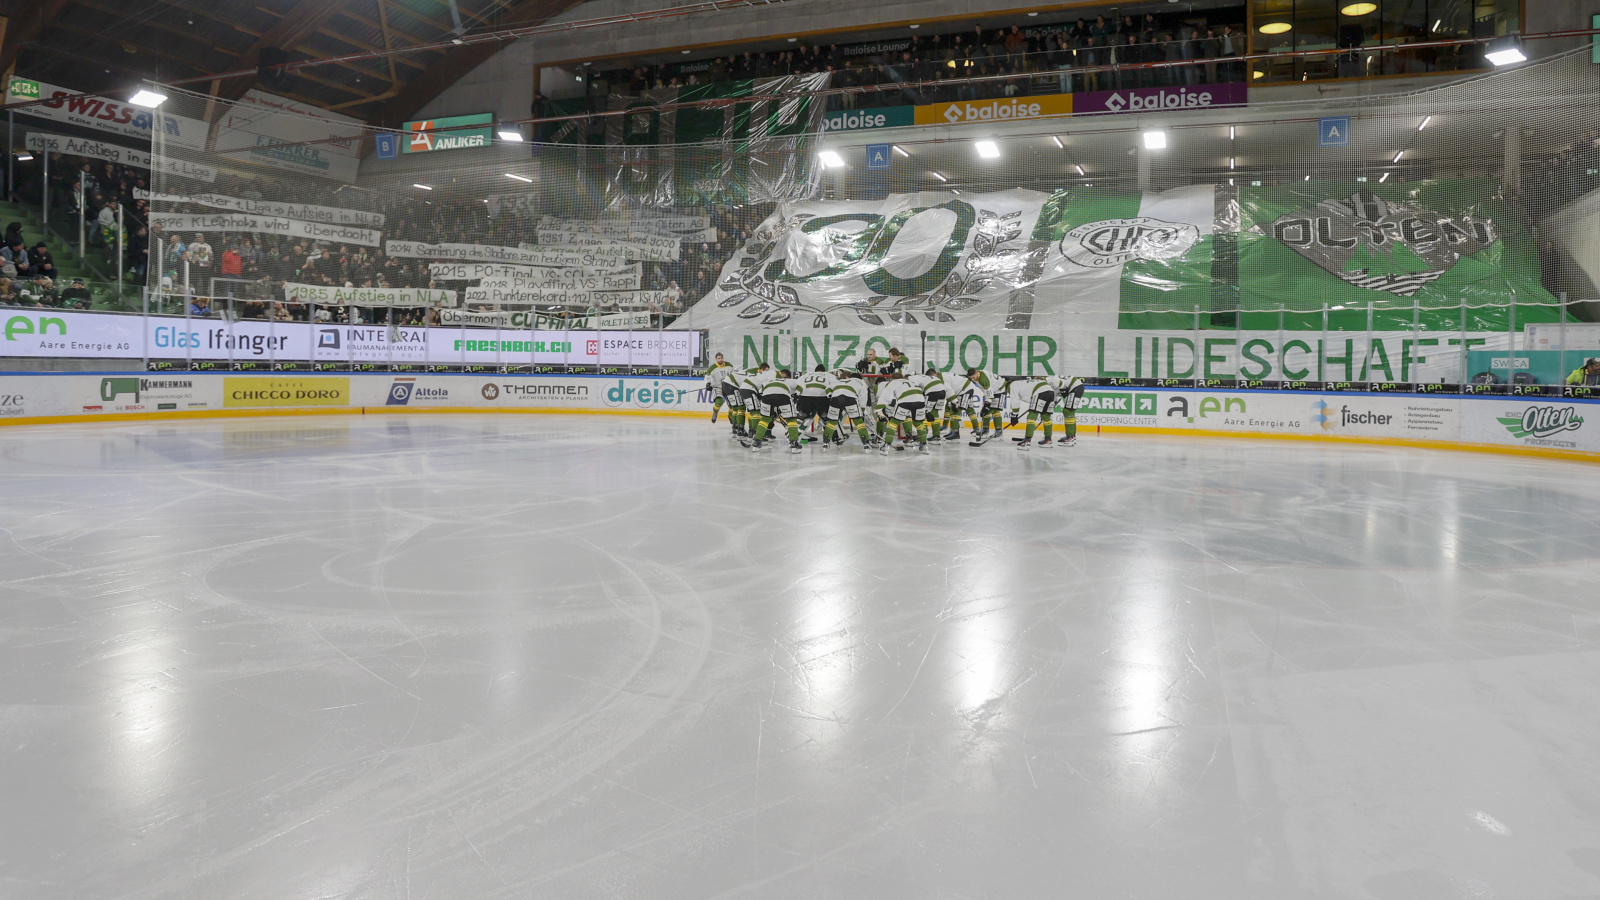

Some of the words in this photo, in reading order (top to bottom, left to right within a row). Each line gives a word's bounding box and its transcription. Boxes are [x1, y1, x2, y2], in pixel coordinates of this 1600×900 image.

[844, 45, 876, 56] Baloise
[1130, 88, 1212, 110] baloise
[966, 99, 1041, 120] baloise
[68, 116, 92, 126] Kälte
[96, 122, 120, 132] Klima
[1329, 126, 1340, 137] A
[381, 142, 390, 151] B
[435, 135, 485, 150] ANLIKER
[66, 139, 120, 161] Aufstieg
[128, 151, 139, 162] in
[874, 151, 884, 162] A
[690, 219, 704, 228] AG
[265, 218, 290, 230] wird
[304, 223, 374, 243] überdacht
[1272, 215, 1494, 249] OLTEN
[469, 247, 483, 258] des
[520, 253, 538, 263] zum
[581, 254, 617, 268] Stand
[432, 265, 466, 278] 2015
[603, 274, 636, 289] Rappi
[289, 286, 328, 300] 1985
[334, 288, 395, 303] Aufstieg
[400, 289, 411, 301] in
[417, 289, 449, 303] NLA
[154, 326, 201, 348] Glas
[208, 328, 288, 355] Ifanger
[347, 329, 427, 343] INTERAL
[40, 340, 66, 349] Aare
[71, 341, 111, 351] Energie
[116, 342, 130, 350] AG
[604, 339, 644, 350] ESPACE
[647, 340, 688, 350] BROKER
[927, 334, 1057, 376] JOHR
[1493, 360, 1528, 368] SWCA
[141, 378, 193, 391] KAMMERMANN
[503, 384, 588, 395] THOMMEN
[232, 389, 291, 400] CHICCO
[296, 389, 340, 400] D'ORO
[415, 387, 448, 397] Altola
[607, 380, 687, 404] dreier
[1, 394, 24, 407] ze
[1341, 405, 1392, 427] fischer
[1522, 405, 1580, 435] Olten
[1224, 418, 1247, 426] Aare
[1249, 419, 1284, 428] Energie
[1288, 420, 1301, 428] AG
[1524, 438, 1577, 448] PROSPECTS
